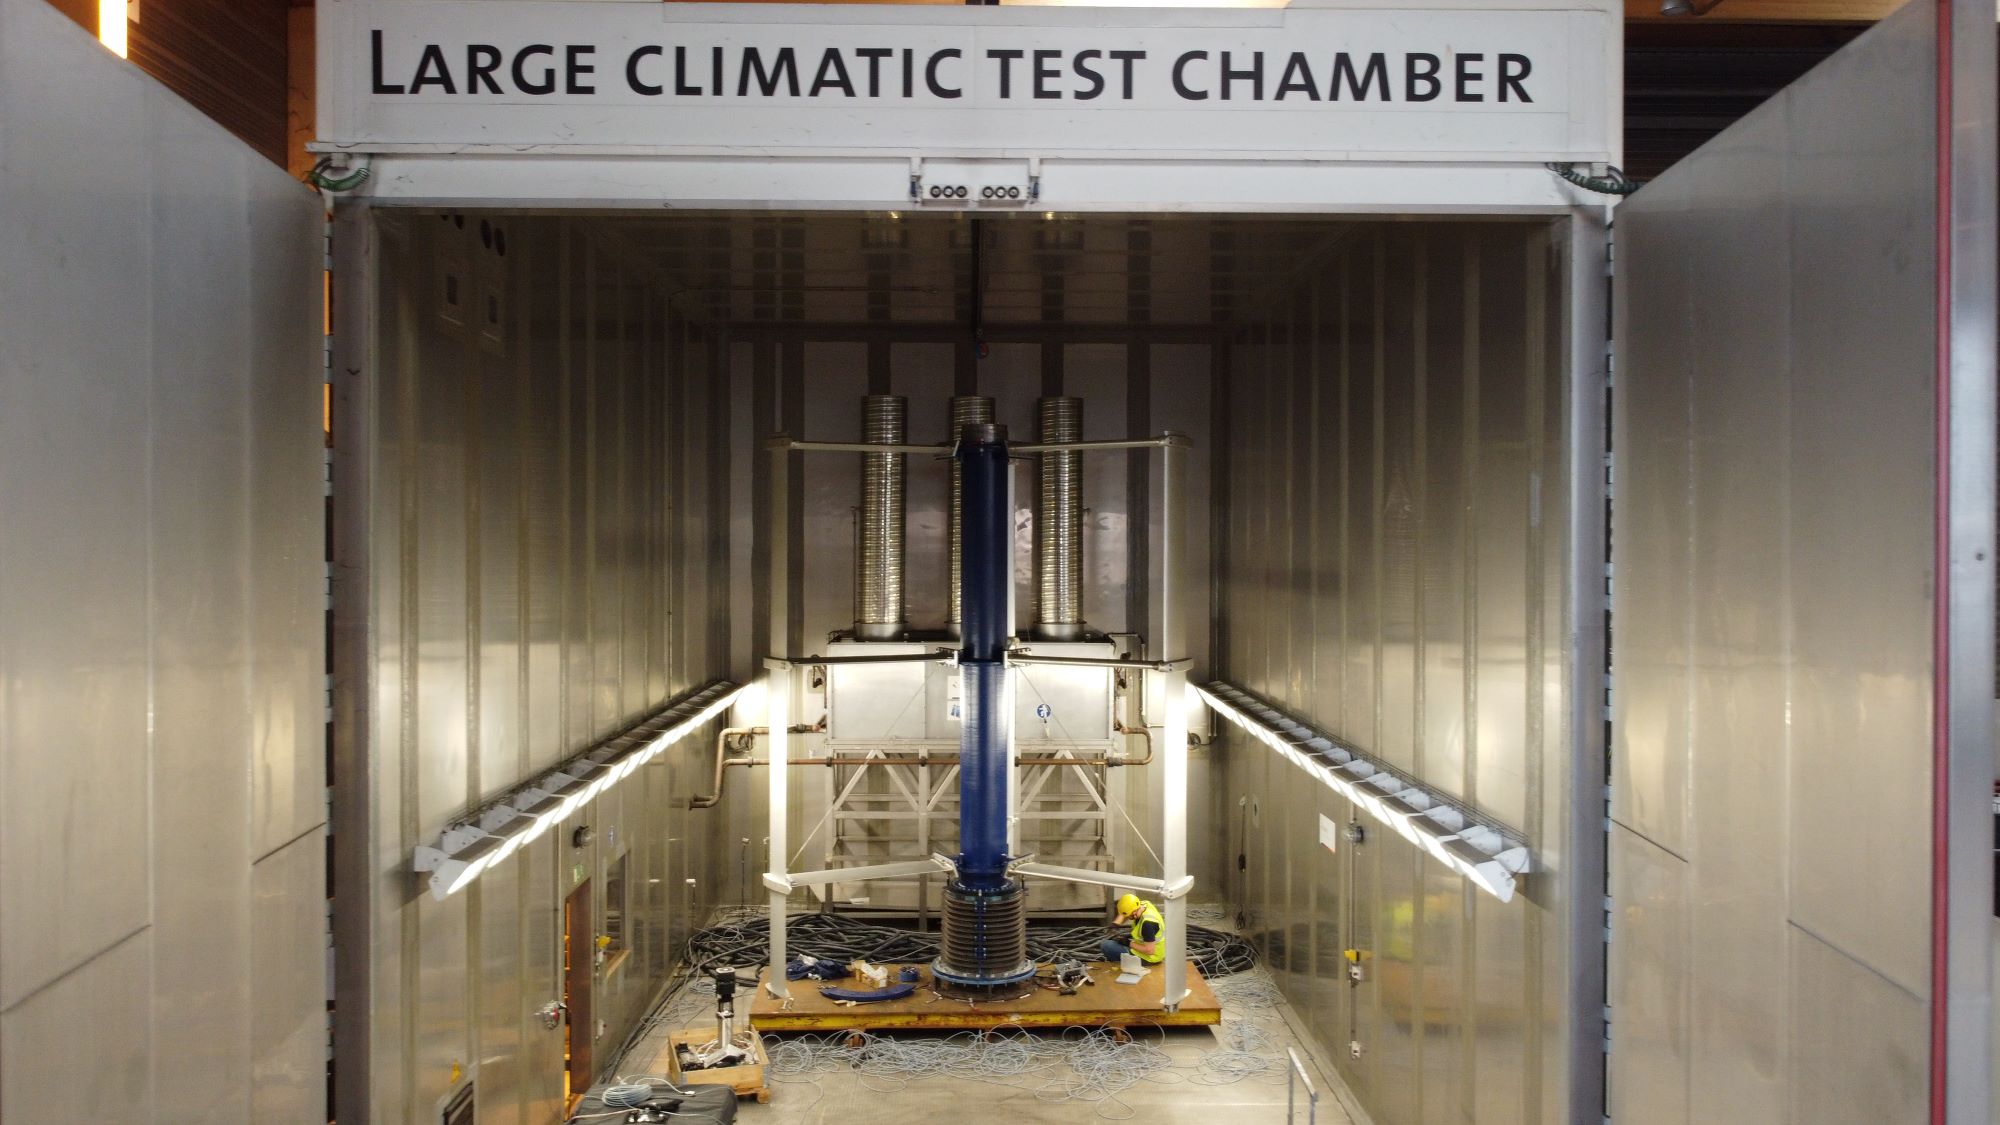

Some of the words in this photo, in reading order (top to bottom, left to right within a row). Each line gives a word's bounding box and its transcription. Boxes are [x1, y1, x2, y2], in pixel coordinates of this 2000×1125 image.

[370, 29, 596, 96] LARGE
[625, 44, 962, 99] CLIMATIC
[986, 49, 1147, 101] TEST
[1172, 50, 1534, 104] CHAMBER
